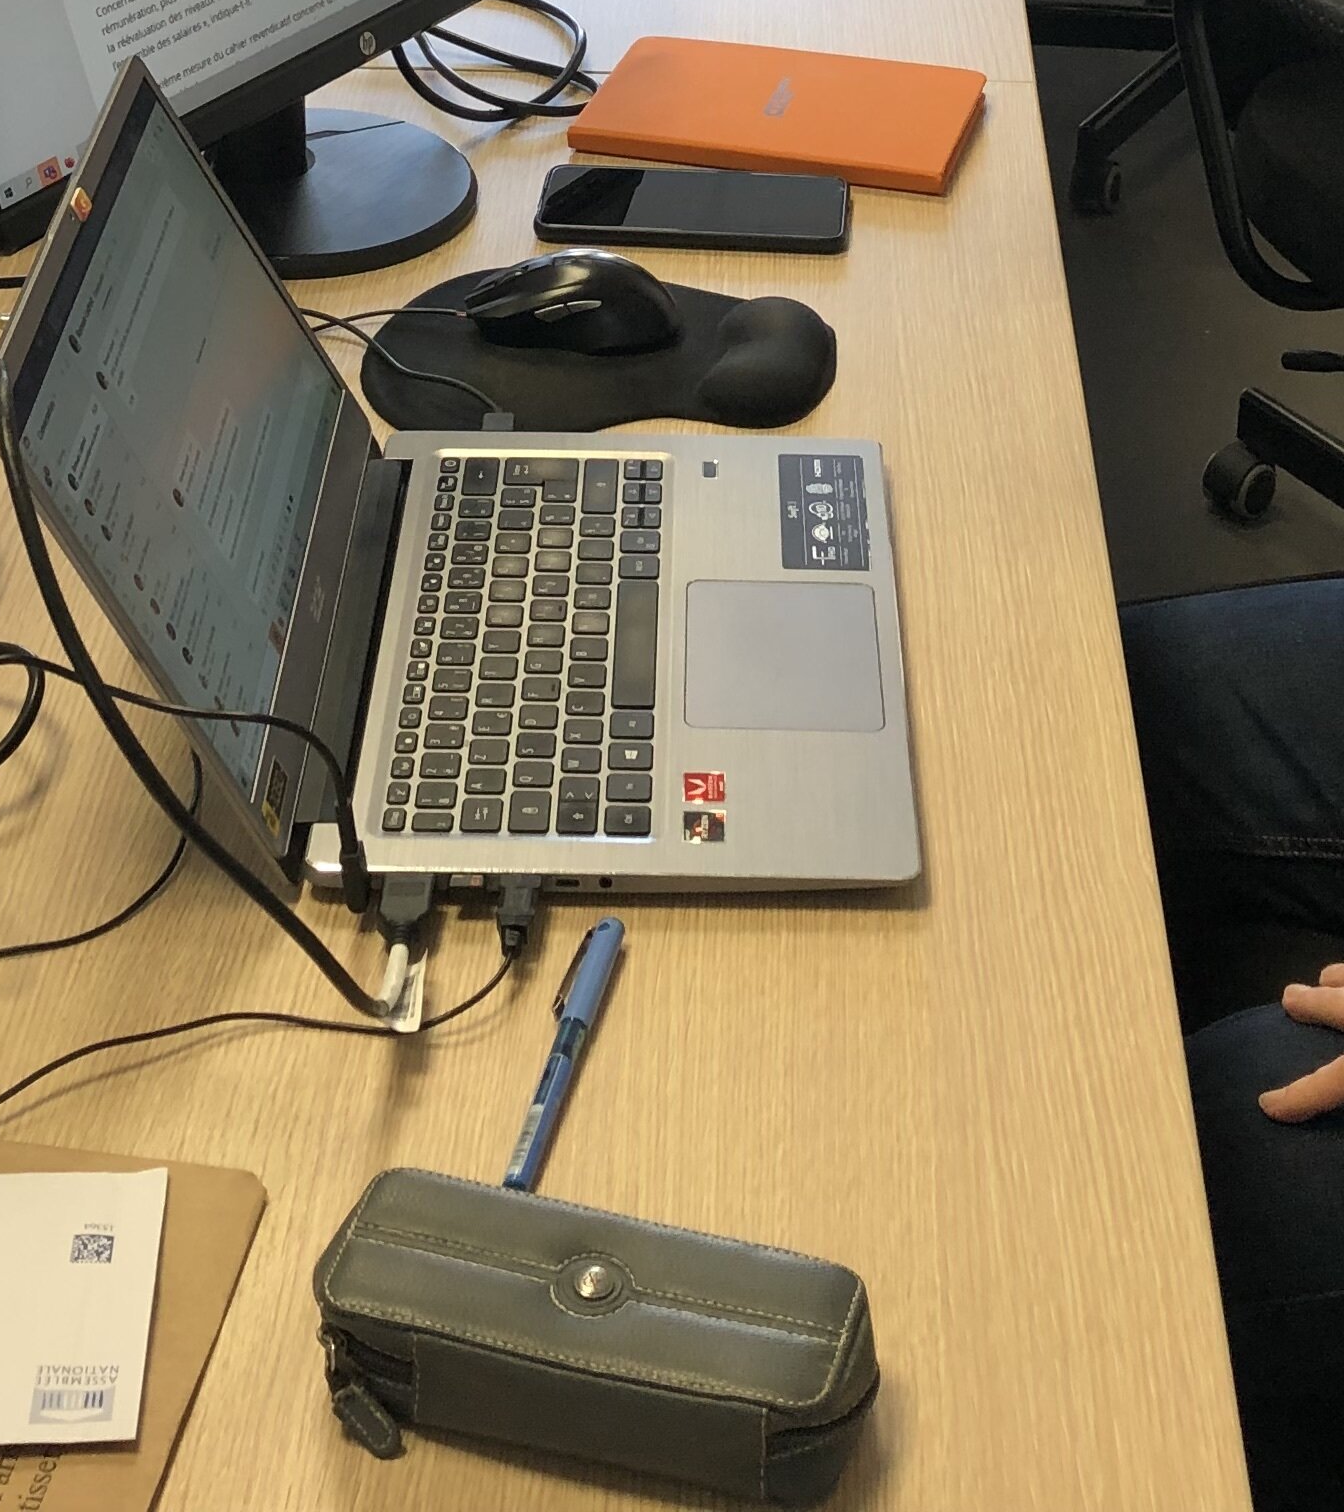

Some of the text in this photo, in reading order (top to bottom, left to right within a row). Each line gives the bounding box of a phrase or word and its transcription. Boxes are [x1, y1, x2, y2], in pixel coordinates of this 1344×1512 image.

[170, 21, 202, 43] salaires
[181, 38, 247, 78] mesure cahier
[36, 1364, 120, 1376] NATIONALE
[35, 1374, 119, 1386] ASSEMBLÉE
